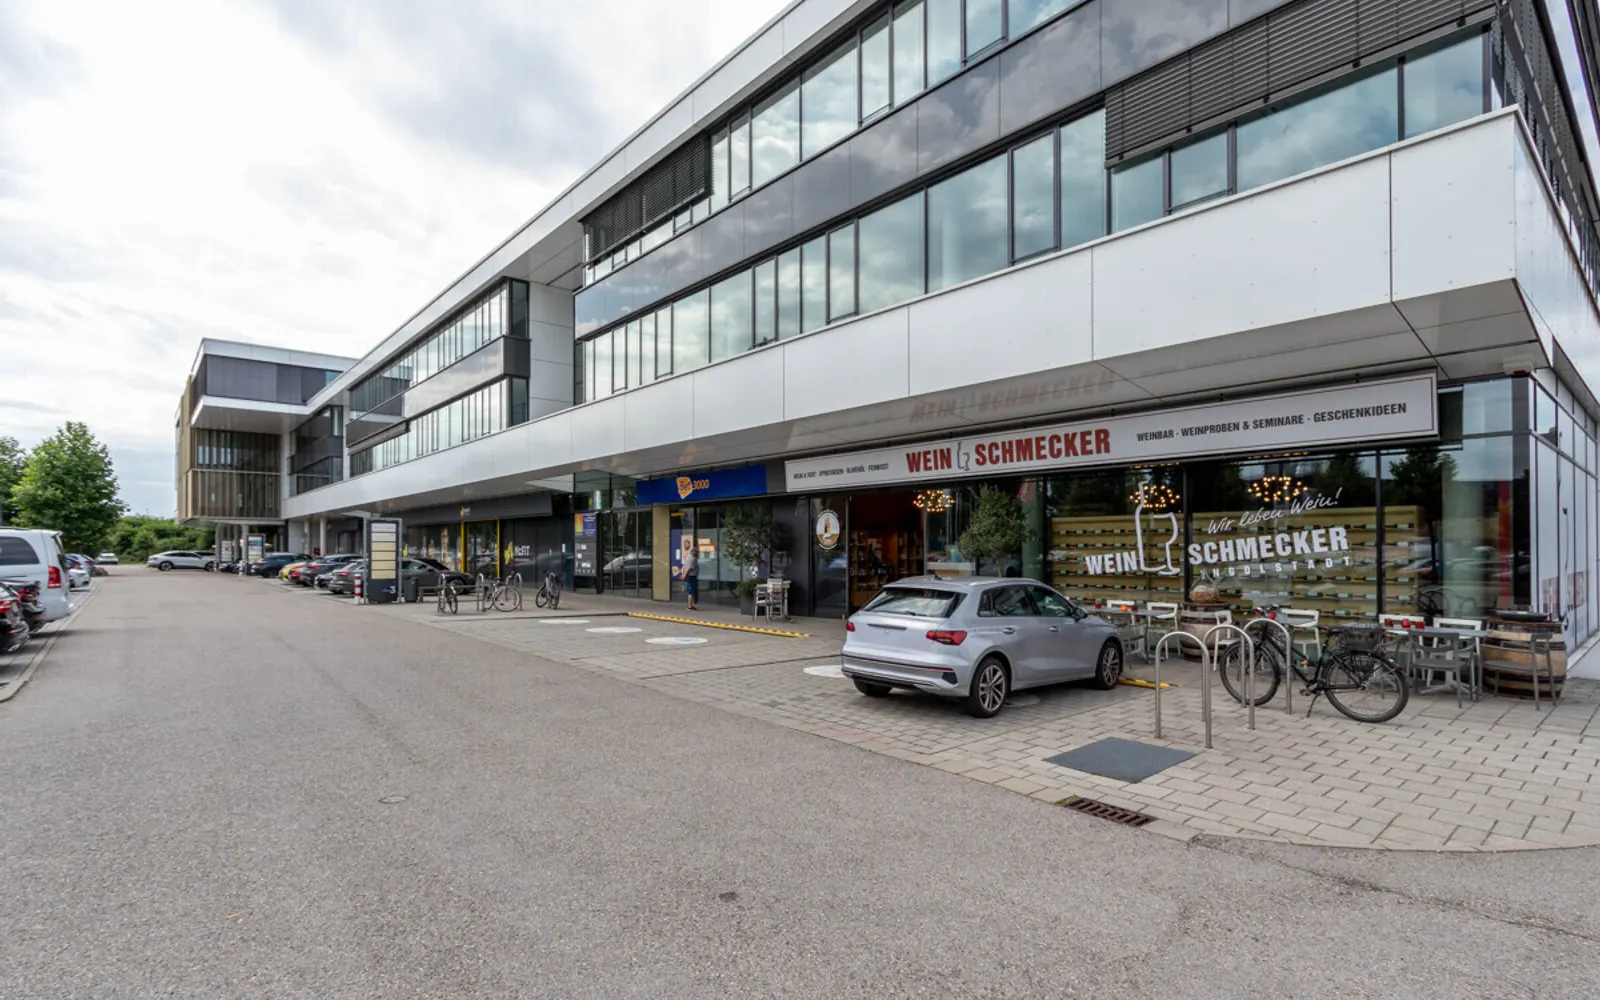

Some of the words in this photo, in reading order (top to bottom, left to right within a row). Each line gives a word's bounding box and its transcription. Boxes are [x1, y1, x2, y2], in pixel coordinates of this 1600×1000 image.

[1136, 429, 1175, 442] WEINBAR
[1181, 421, 1240, 437] WEINPROBEN
[1242, 421, 1250, 430] &
[1252, 414, 1305, 430] SEMINARE
[1313, 402, 1407, 423] GESCHENKIDEEN
[906, 447, 952, 473] WEIN
[974, 428, 1111, 466] SCHMECKER
[693, 479, 709, 490] 3000
[1207, 517, 1235, 535] Wir
[1238, 506, 1285, 527] leben
[1290, 486, 1343, 515] Wein!
[1085, 551, 1138, 575] WEIN
[1188, 526, 1349, 566] SCHMECKER
[1200, 556, 1351, 580] INGOLSTADT
